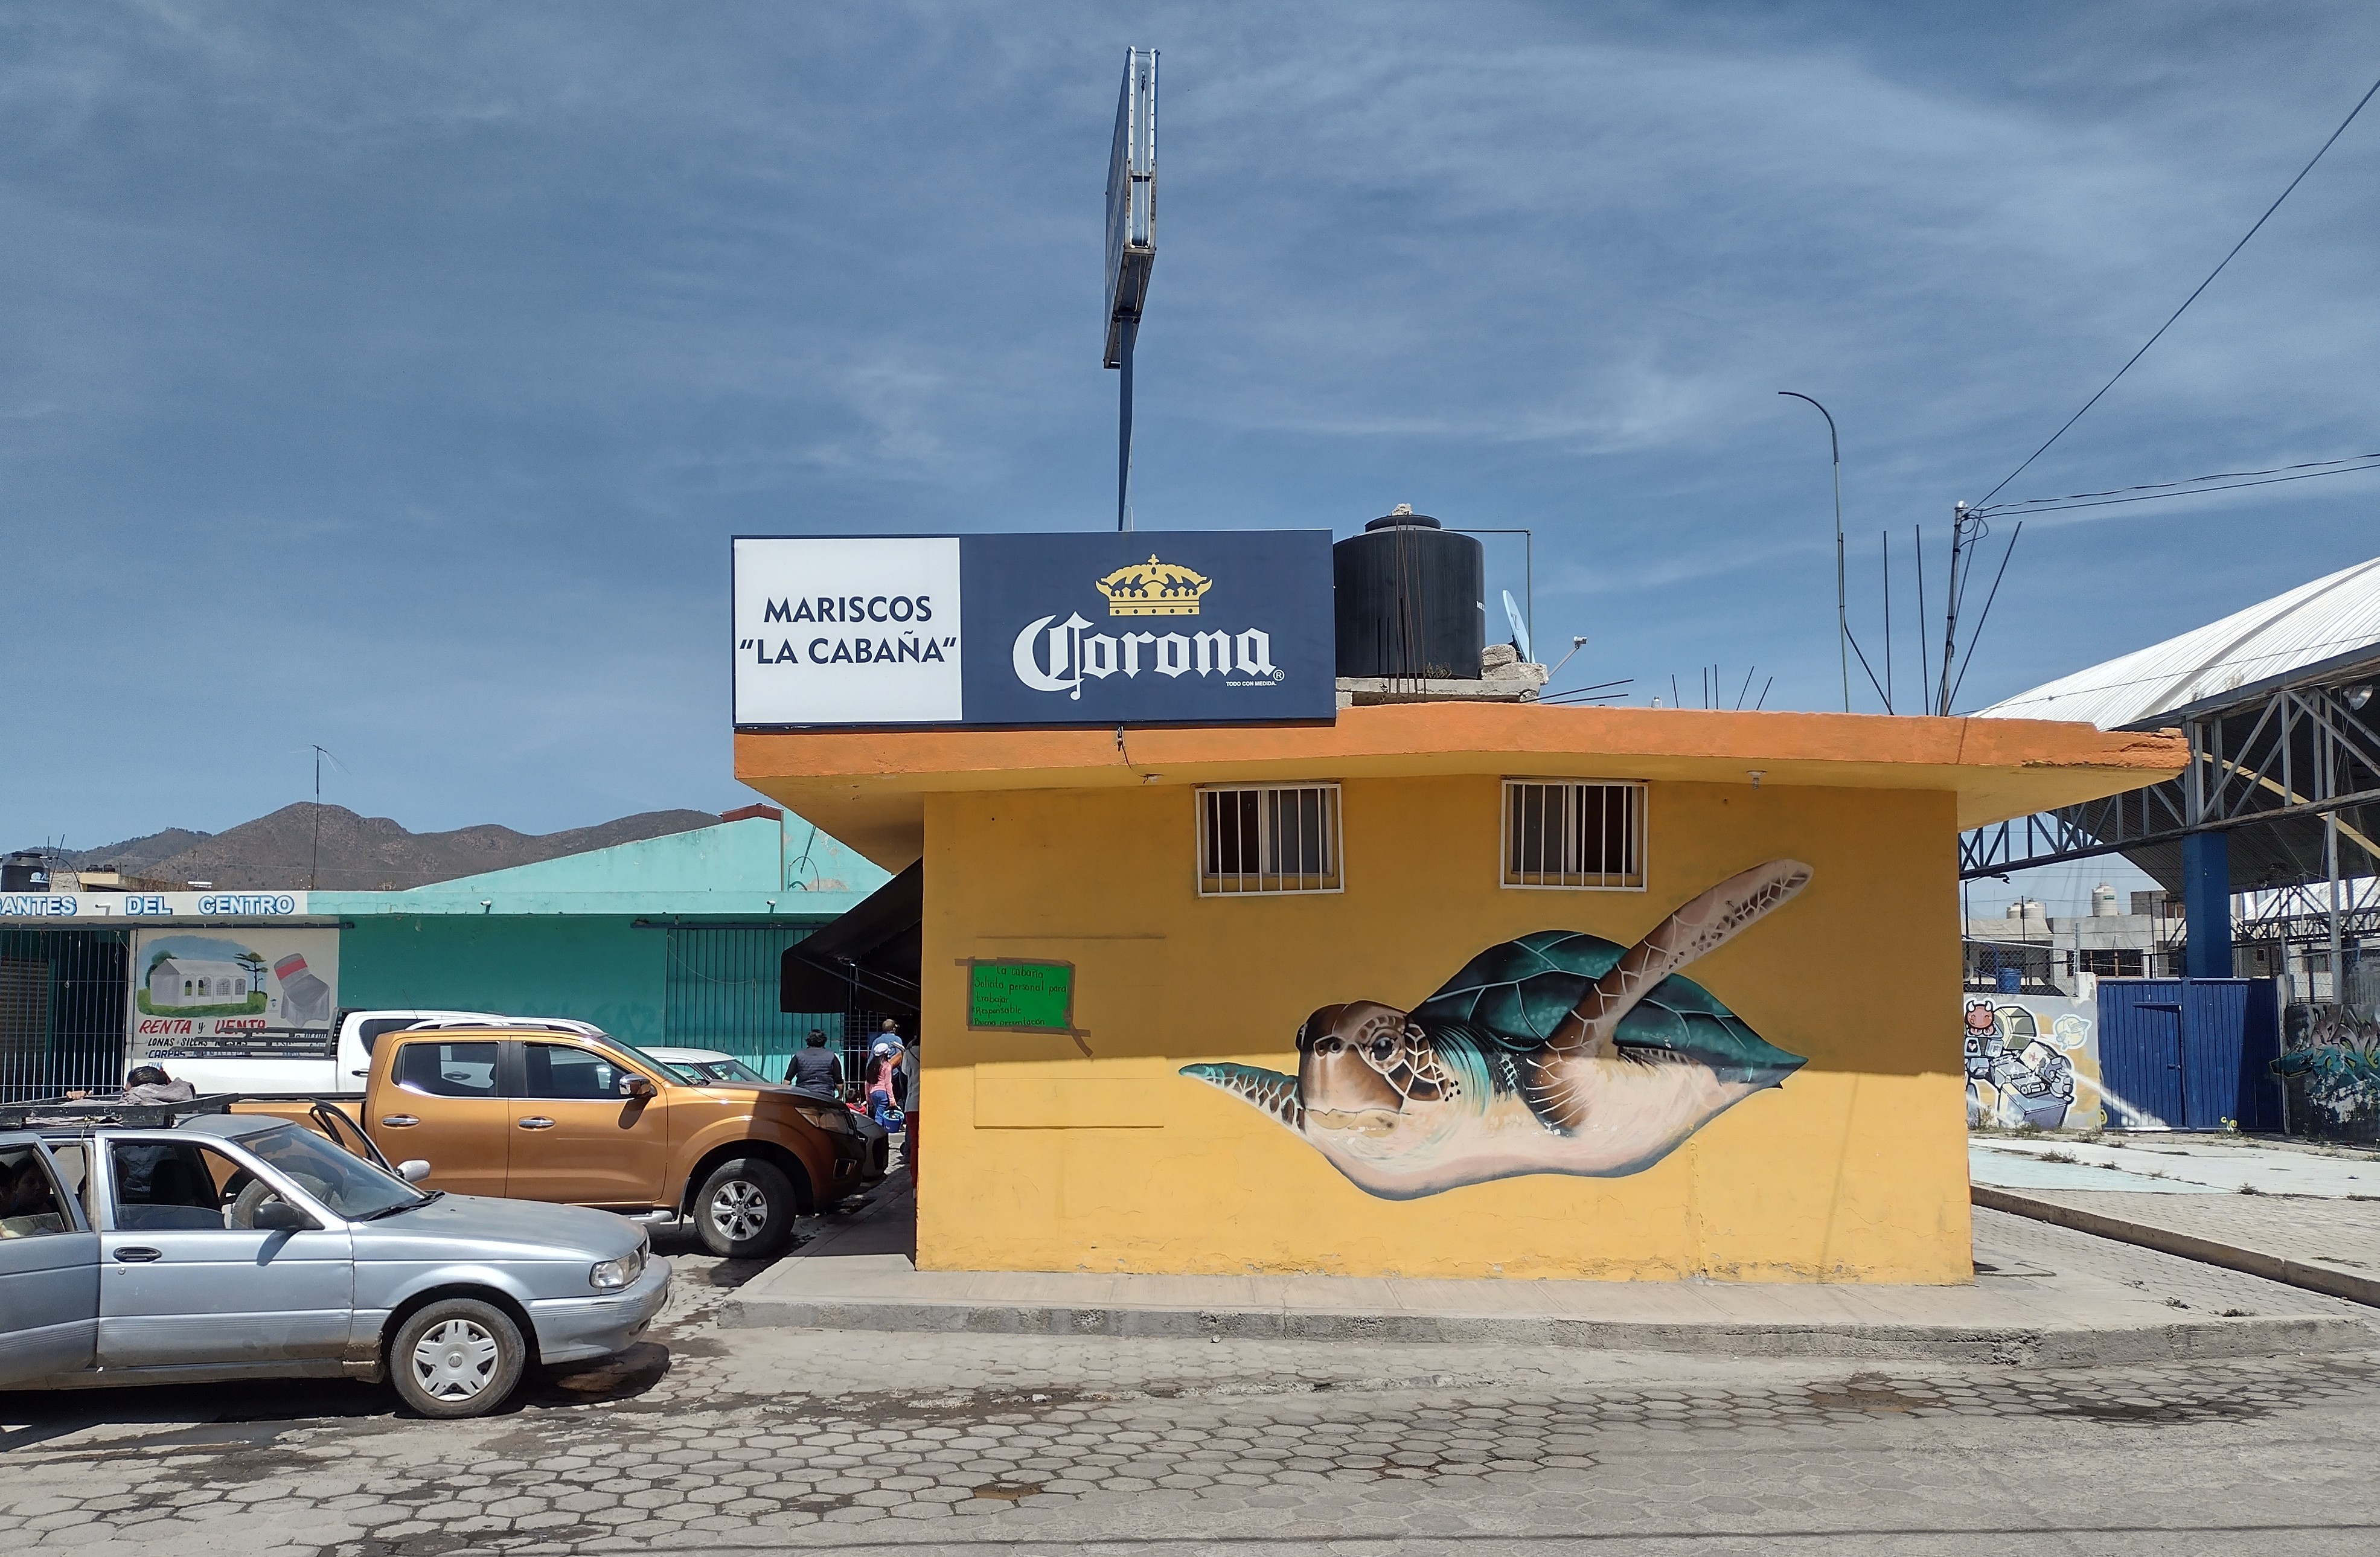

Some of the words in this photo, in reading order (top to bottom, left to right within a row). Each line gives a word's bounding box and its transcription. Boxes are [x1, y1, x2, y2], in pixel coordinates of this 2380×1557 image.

[764, 595, 932, 624] MARISCOS
[1012, 611, 1276, 700] Corona
[0, 896, 77, 916] ANTES
[126, 895, 173, 916] DEL
[198, 895, 295, 915] CENTRO
[1009, 980, 1044, 995] personal
[1049, 986, 1067, 996] para
[976, 991, 1009, 1006] trabajar
[976, 1002, 1022, 1018] Responsable
[139, 1019, 192, 1034] RENTA
[197, 1021, 205, 1034] y
[147, 1037, 175, 1047] LONAS
[148, 1049, 185, 1058] CARPAS
